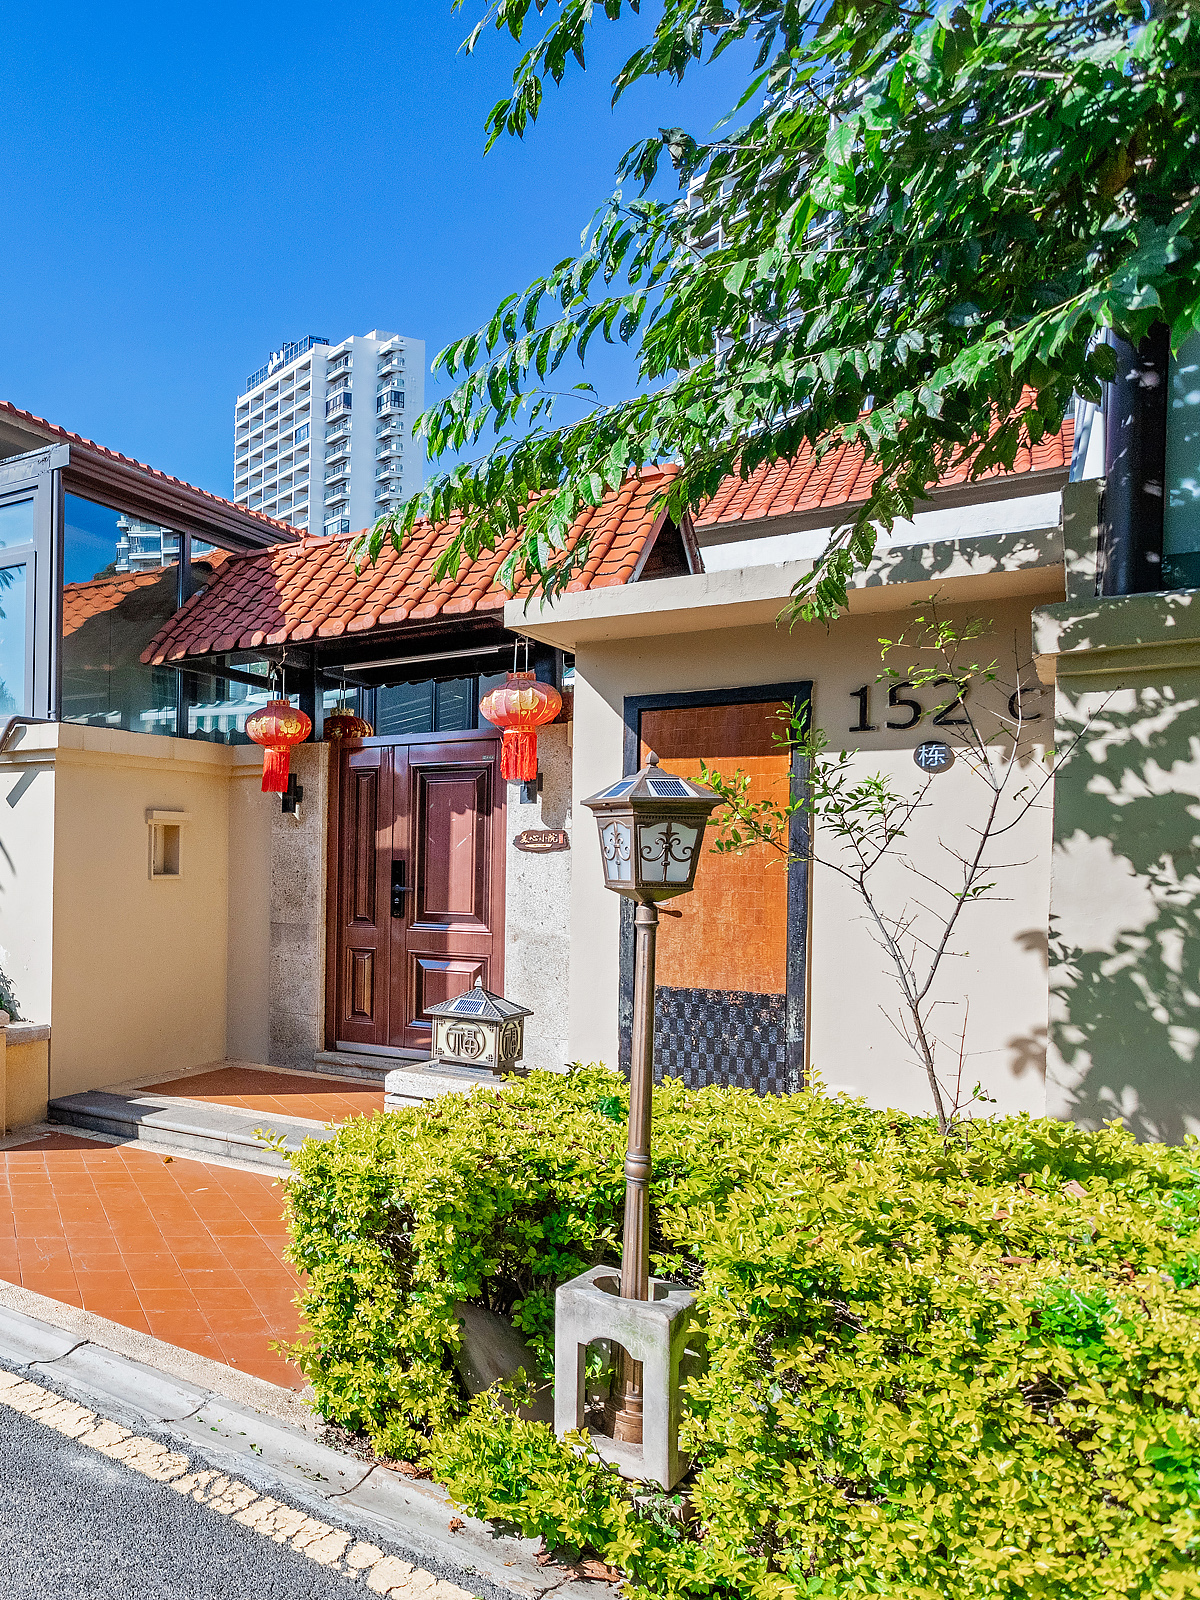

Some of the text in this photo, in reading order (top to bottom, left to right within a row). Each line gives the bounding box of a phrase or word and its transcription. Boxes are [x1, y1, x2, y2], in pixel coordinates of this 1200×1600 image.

[848, 676, 971, 732] 152
[918, 744, 946, 767] 栋
[447, 1021, 485, 1059] 福
